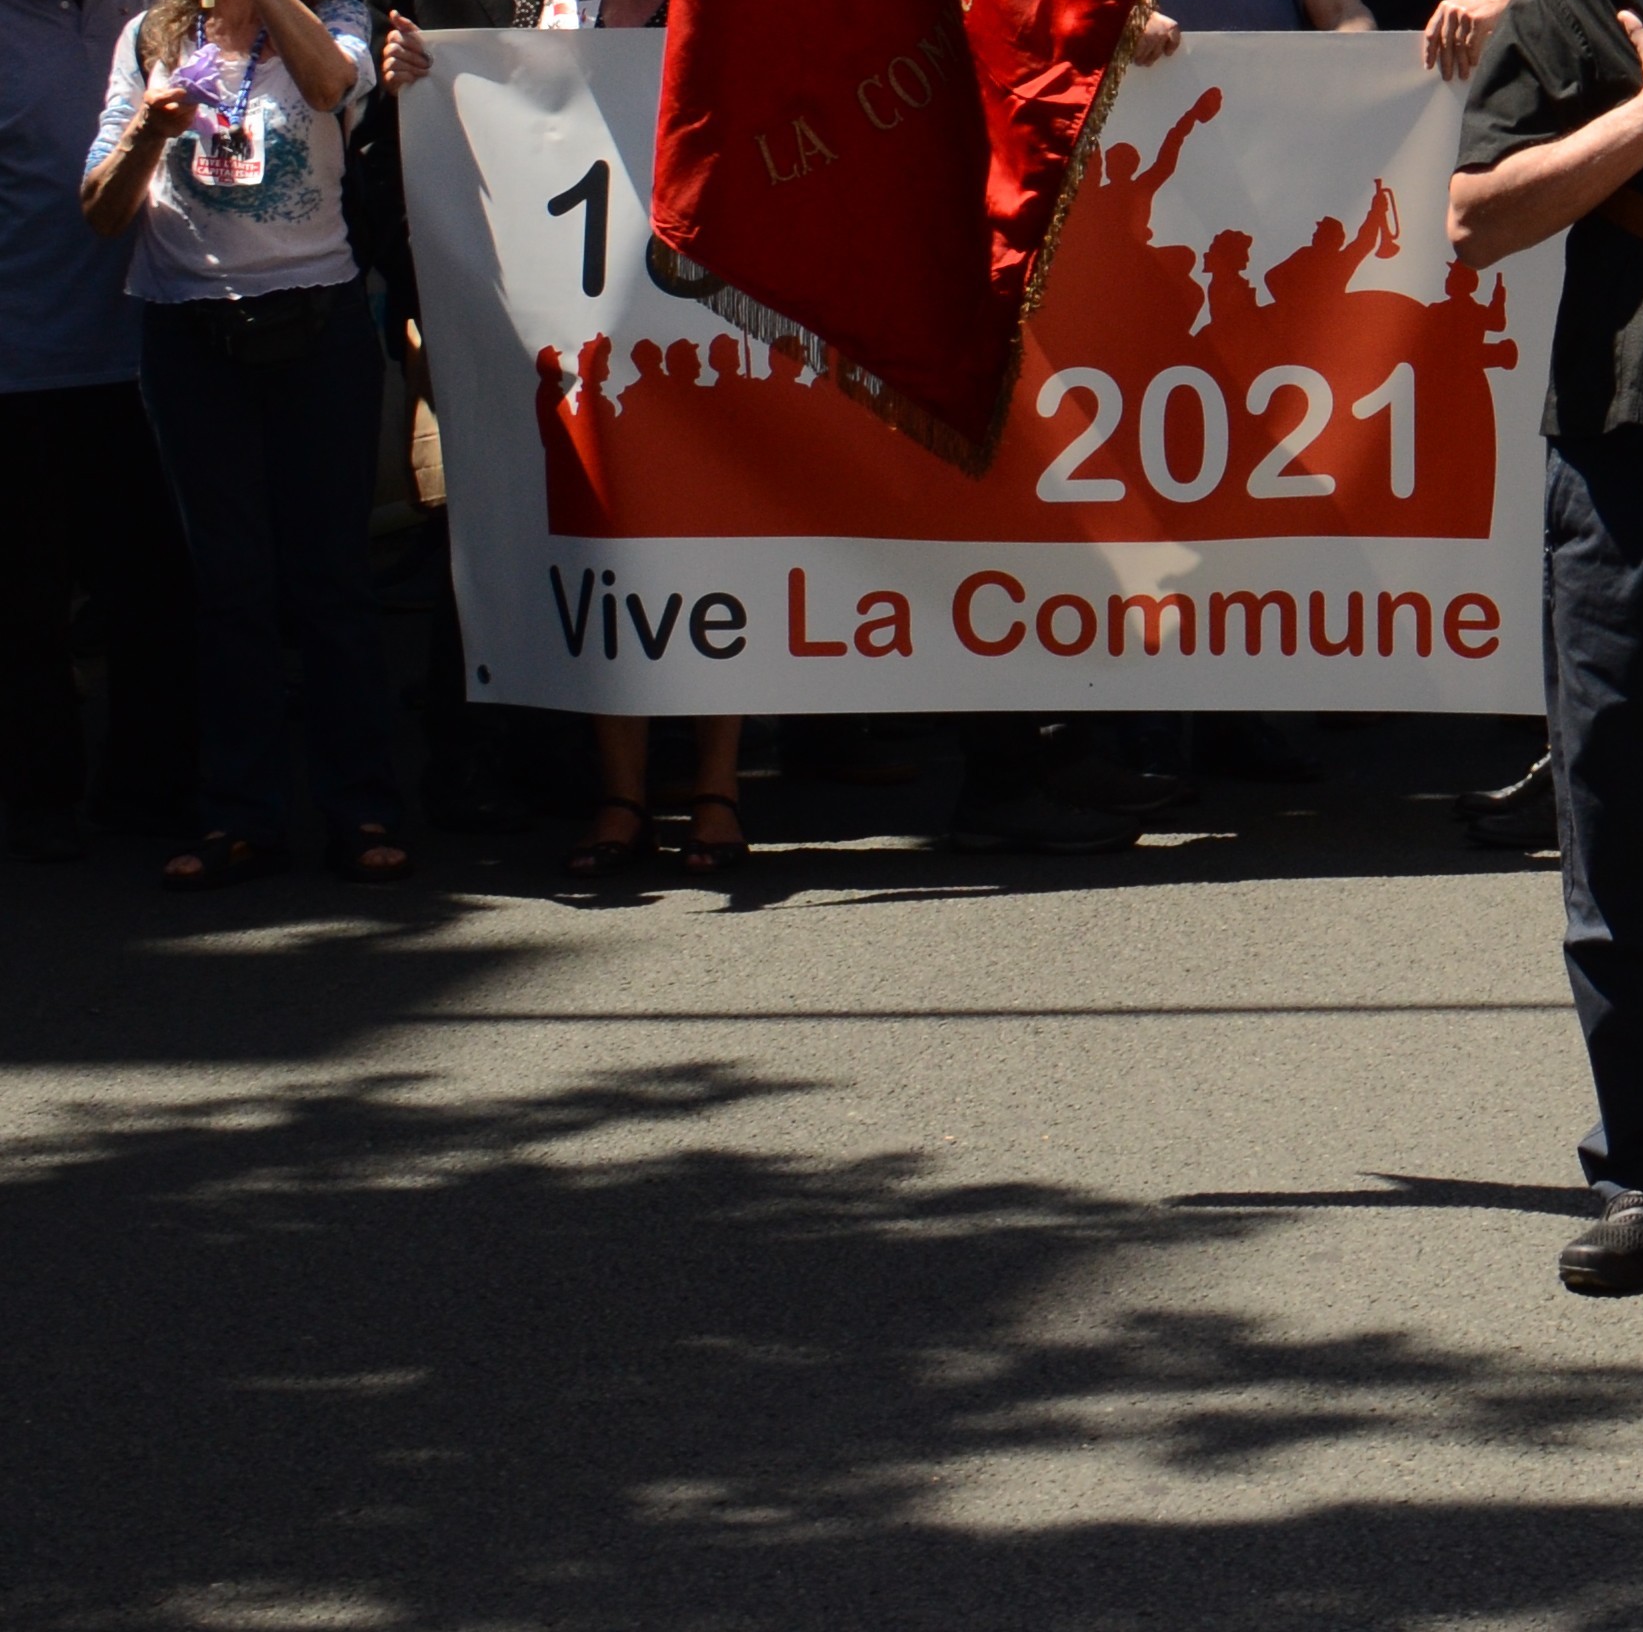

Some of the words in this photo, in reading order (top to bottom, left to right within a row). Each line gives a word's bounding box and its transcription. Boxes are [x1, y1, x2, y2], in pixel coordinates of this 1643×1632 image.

[754, 114, 840, 187] LA
[1033, 361, 1416, 504] 2021
[548, 563, 750, 664] Vive
[787, 567, 913, 660] La
[951, 570, 1502, 662] Commune
